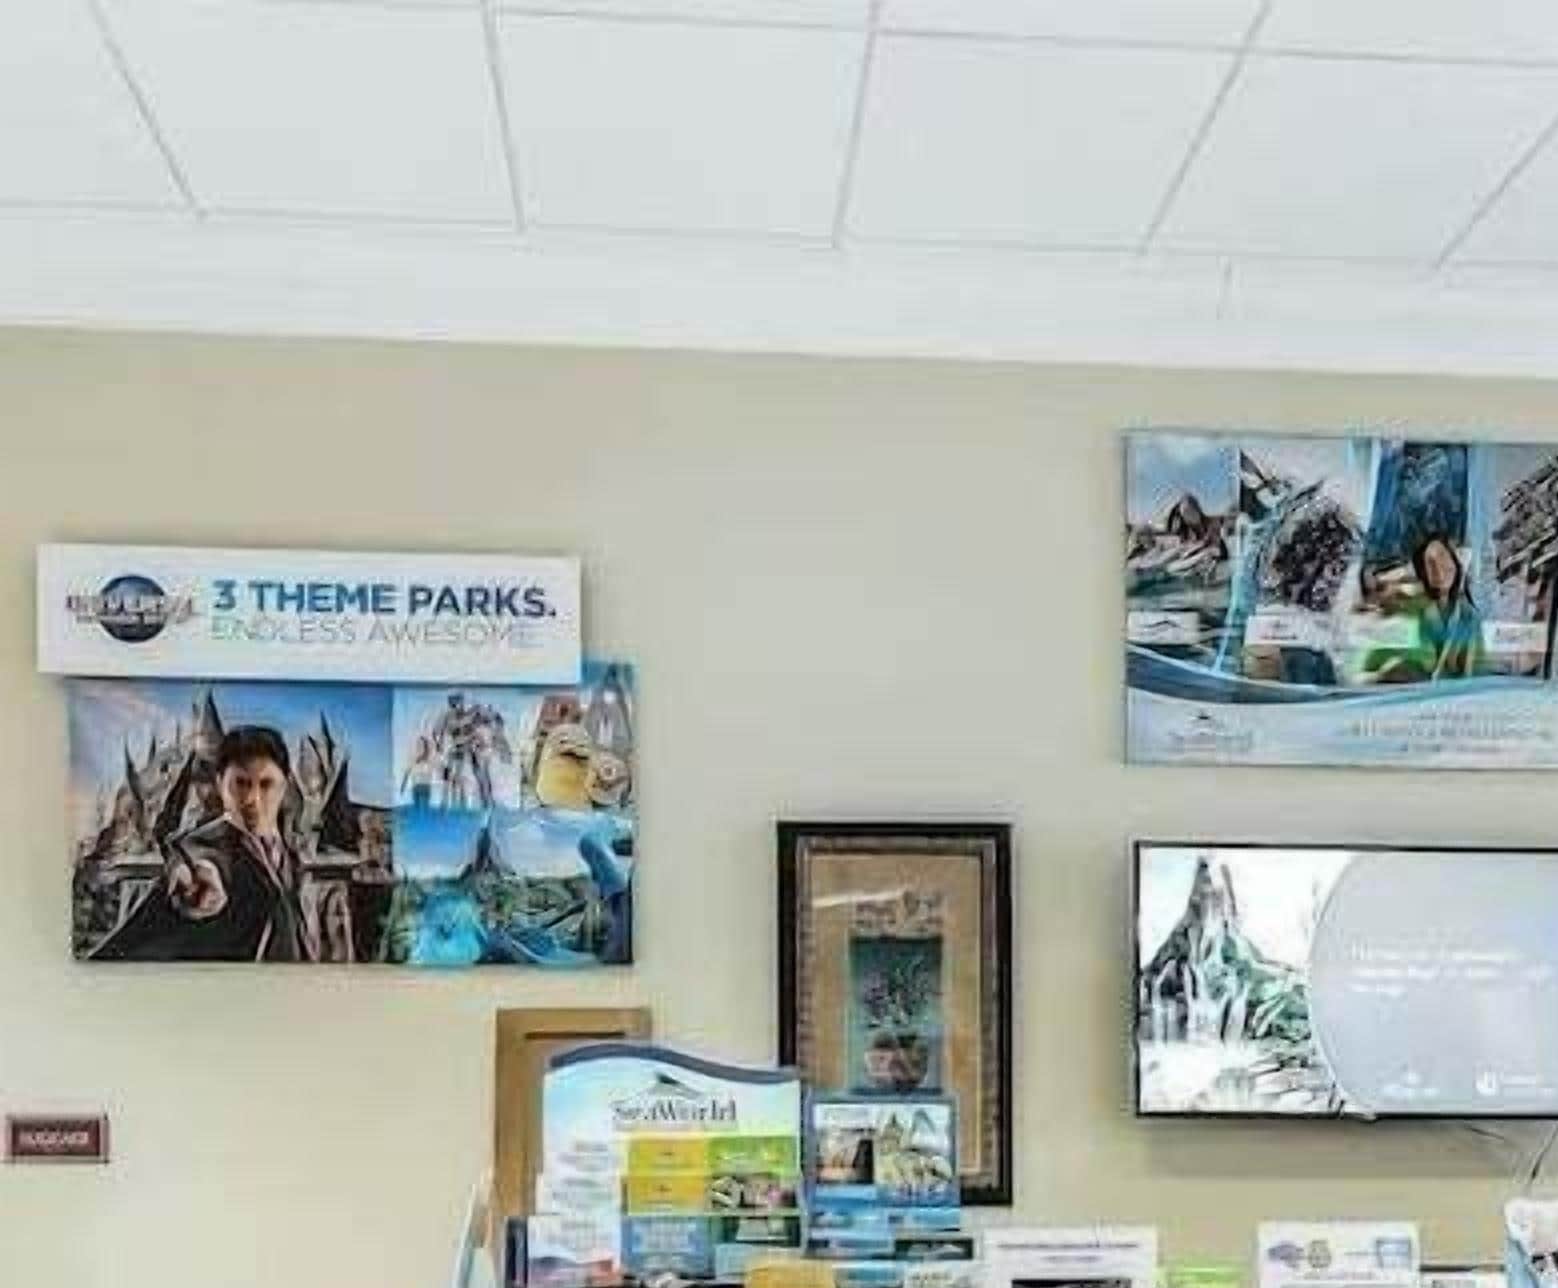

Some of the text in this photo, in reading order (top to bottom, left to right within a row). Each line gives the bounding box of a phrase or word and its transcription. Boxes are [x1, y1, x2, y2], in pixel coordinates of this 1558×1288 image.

[211, 580, 558, 619] 3 THEME PARKS.
[210, 617, 357, 644] ENDLESS
[611, 1097, 737, 1122] SeaWorld
